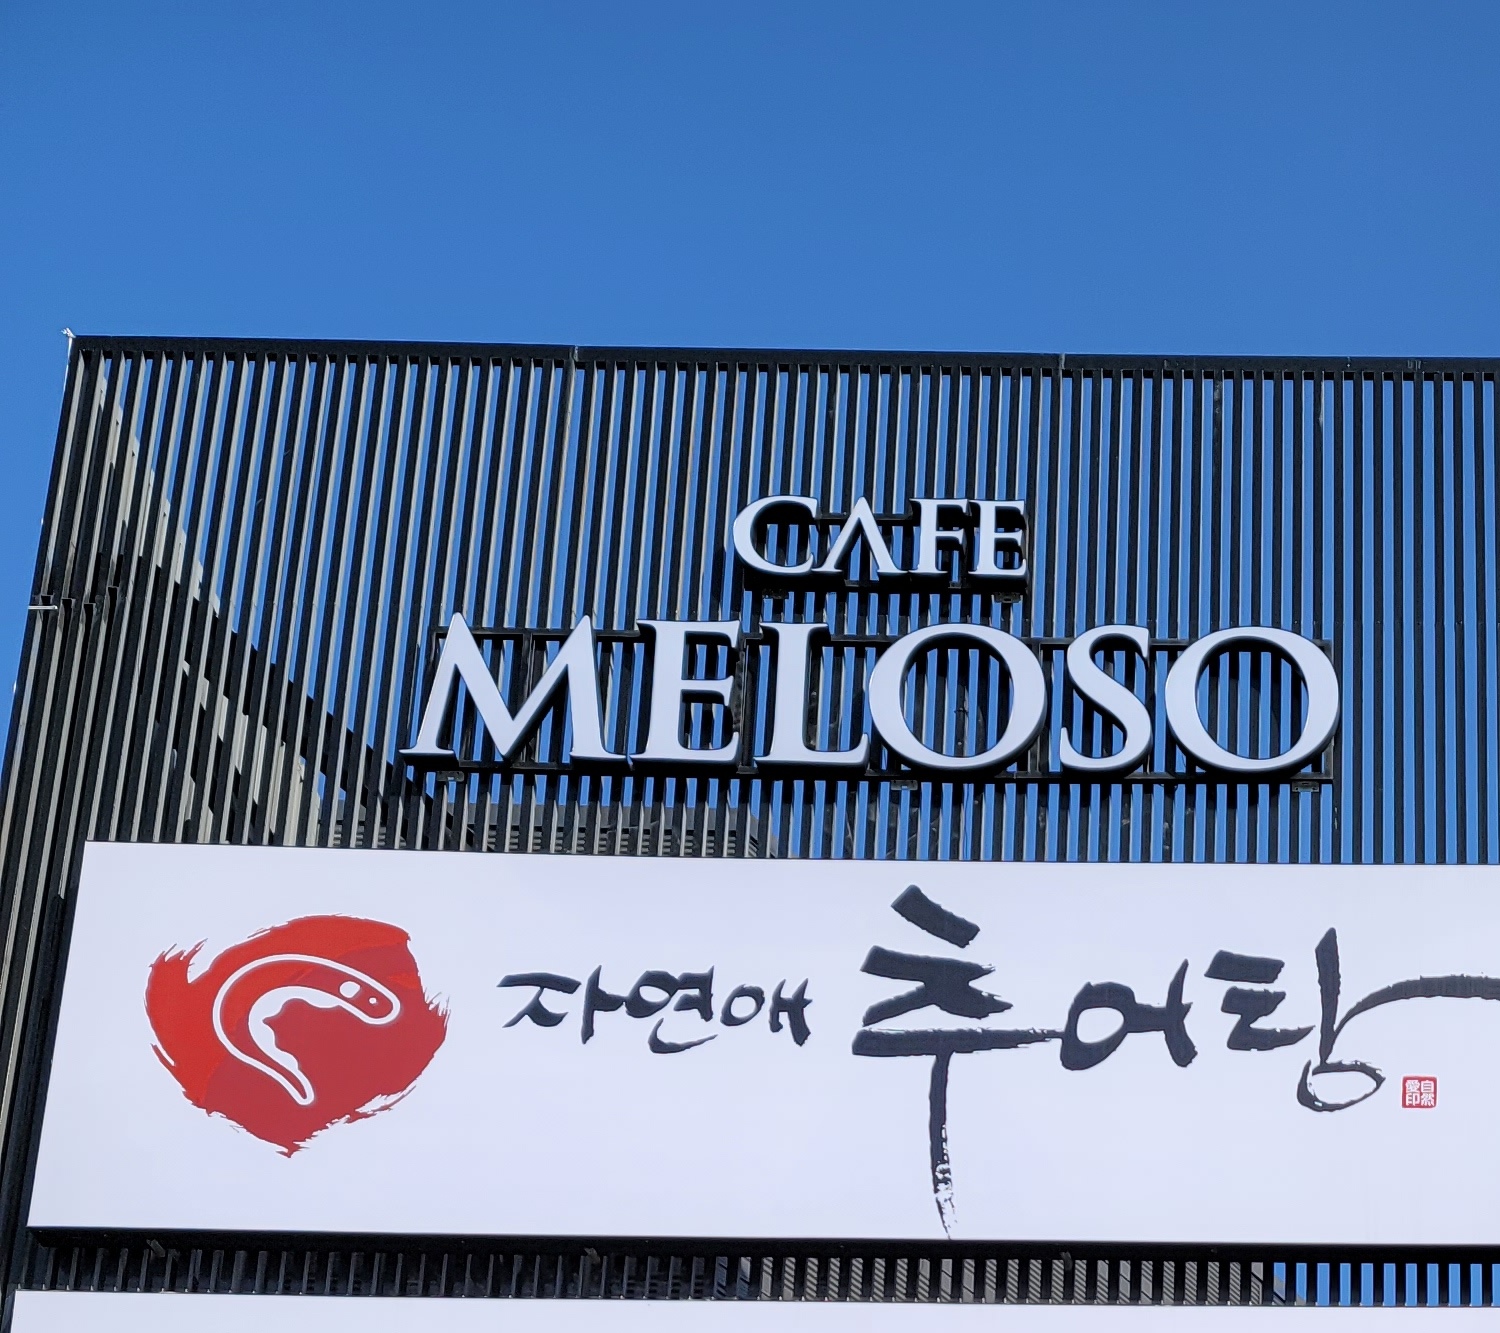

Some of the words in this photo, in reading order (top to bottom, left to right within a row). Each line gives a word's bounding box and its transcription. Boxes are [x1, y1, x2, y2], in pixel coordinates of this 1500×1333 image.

[733, 495, 1027, 576] CAFE
[399, 612, 1341, 775] MELOSO
[497, 966, 812, 1054] 자연애
